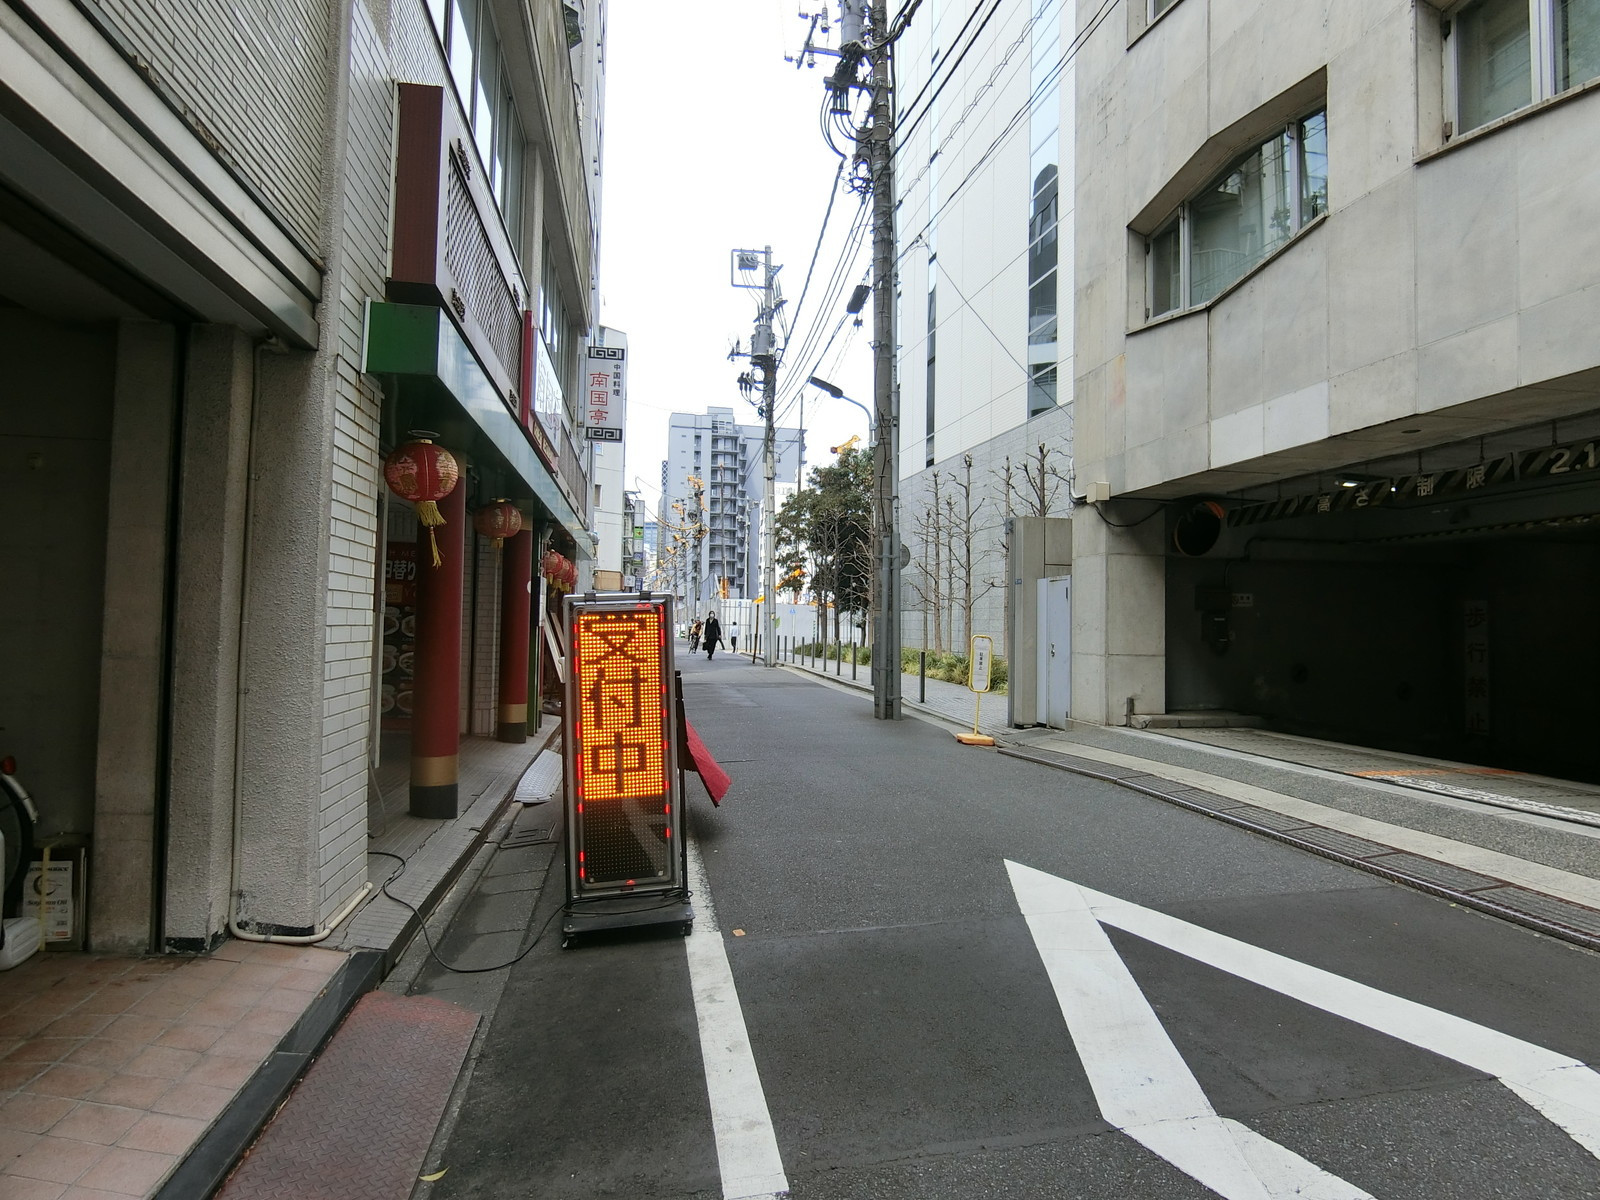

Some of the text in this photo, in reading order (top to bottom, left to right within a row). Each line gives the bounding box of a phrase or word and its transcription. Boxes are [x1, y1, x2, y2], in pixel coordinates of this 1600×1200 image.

[589, 372, 610, 425] 南国亭
[613, 363, 621, 397] 中国料理
[1316, 442, 1595, 513] 高さ制限 2.1
[583, 613, 648, 795] 受付中
